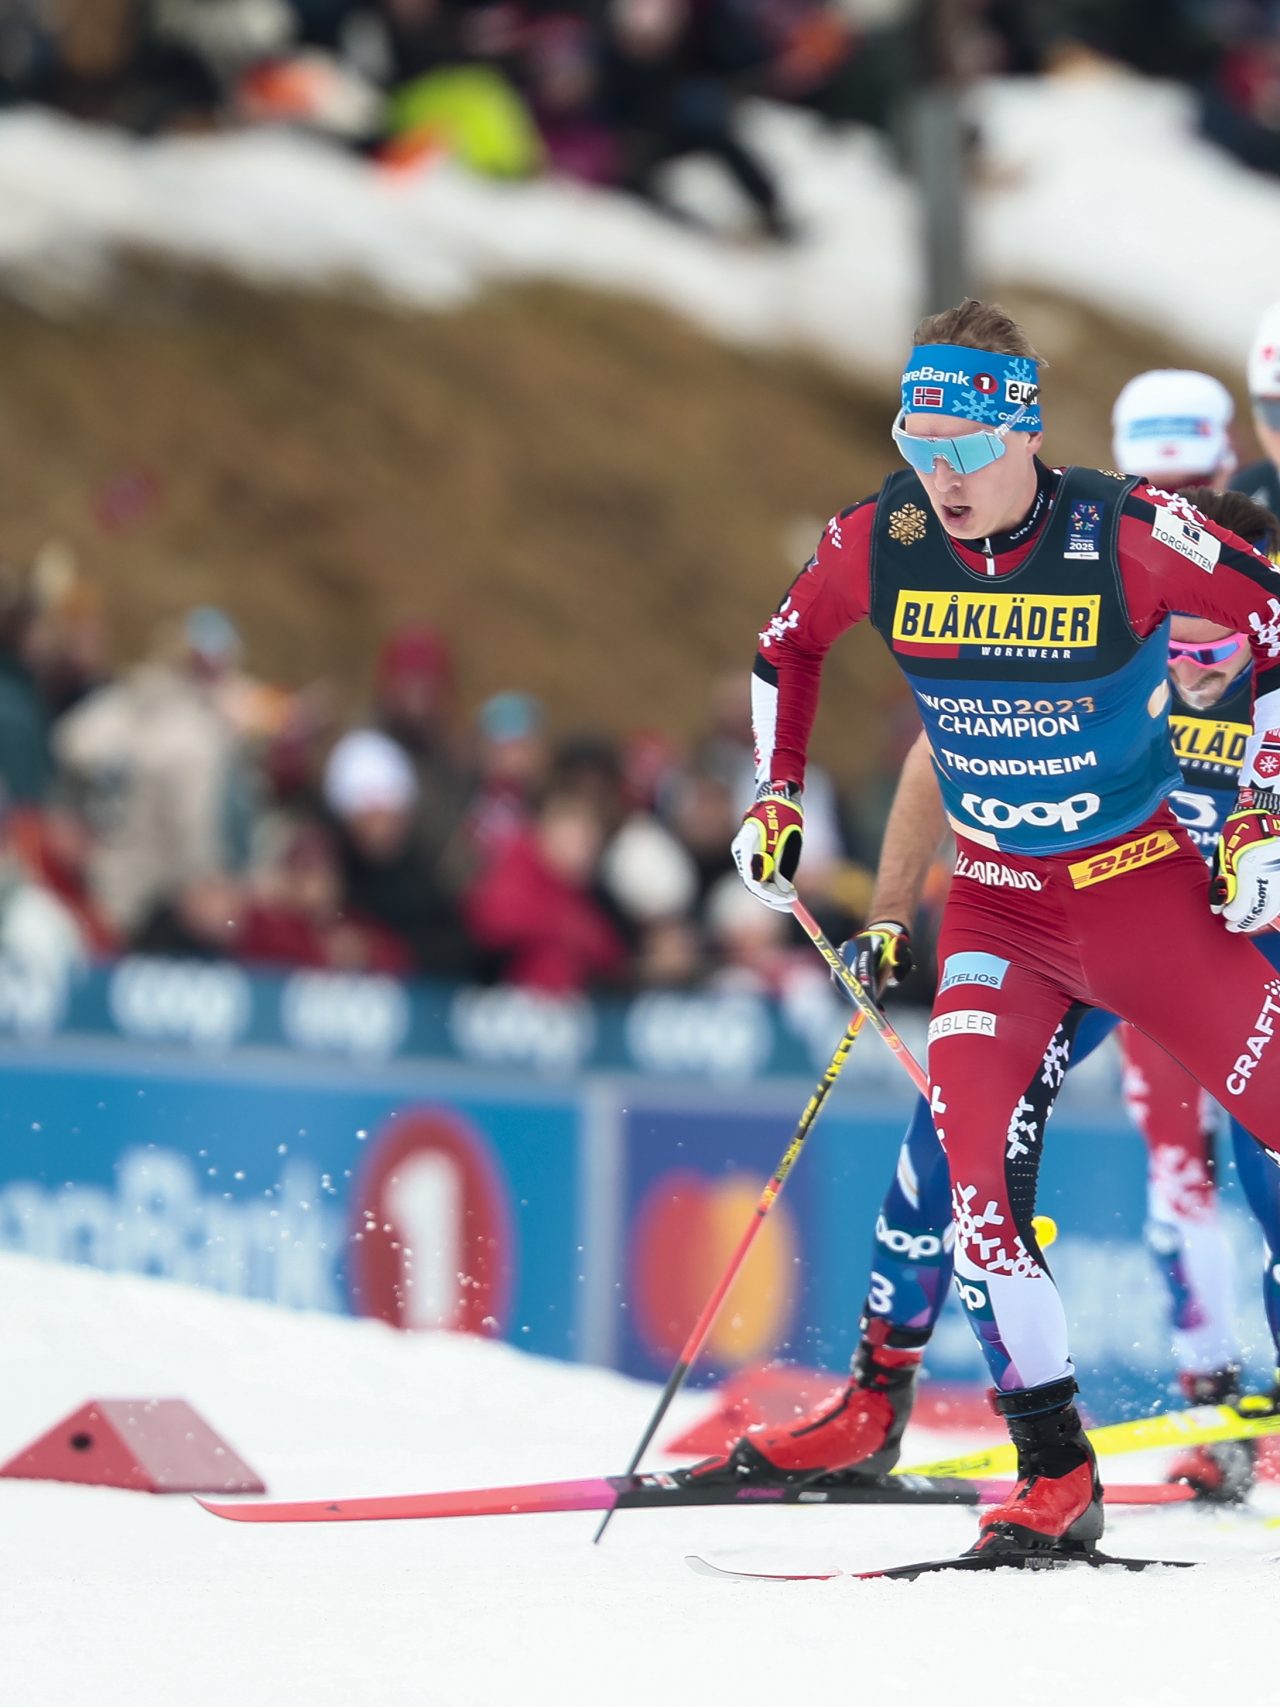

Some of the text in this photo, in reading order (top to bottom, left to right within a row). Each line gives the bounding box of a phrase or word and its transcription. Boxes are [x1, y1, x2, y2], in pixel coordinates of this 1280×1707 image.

[980, 376, 990, 390] 1
[1069, 542, 1095, 551] 2025
[1154, 526, 1213, 571] TORGHATTEN
[901, 594, 1091, 642] BLÅKLÄDER
[981, 646, 1072, 659] WORKWEAR
[914, 689, 1096, 715] WORLD 2023
[937, 714, 1081, 738] CHAMPION
[940, 748, 1098, 776] TRONDHEIM
[765, 805, 779, 846] LEKI
[961, 792, 1101, 833] coop
[1087, 835, 1169, 880] DHL
[1225, 822, 1250, 869] LEKI
[868, 1271, 895, 1314] 3
